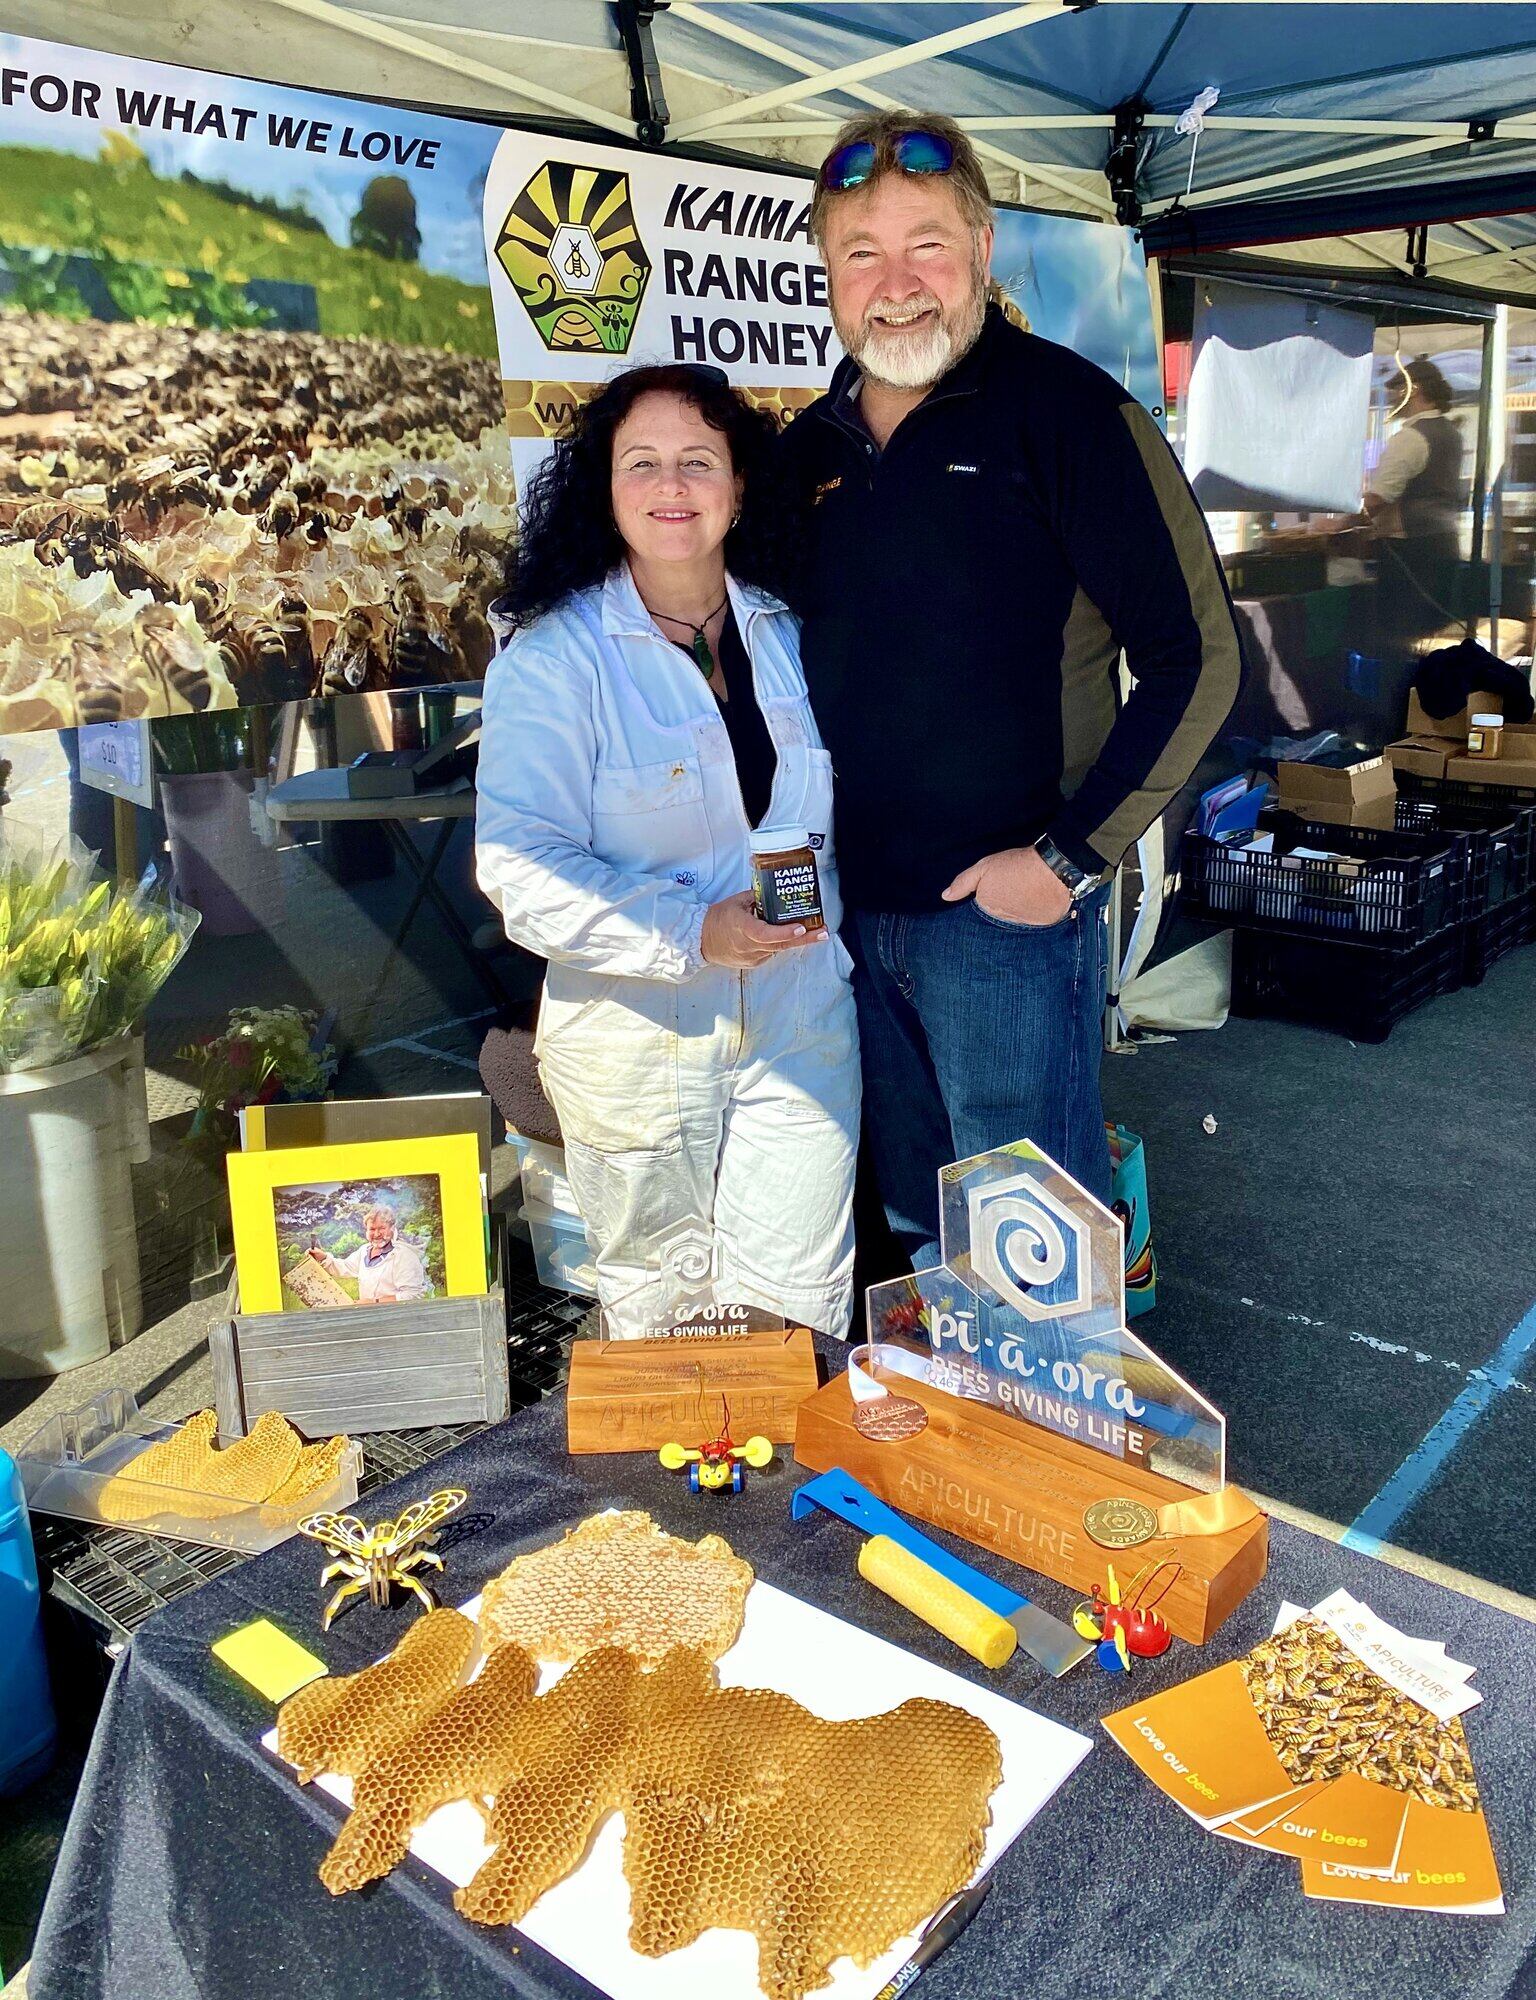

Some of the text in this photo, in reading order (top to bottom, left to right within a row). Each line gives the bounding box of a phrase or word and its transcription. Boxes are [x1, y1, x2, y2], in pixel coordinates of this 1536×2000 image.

[2, 68, 441, 169] FOR WHAT WE LOVE
[663, 183, 815, 245] KAIMA
[663, 249, 829, 307] RANGE
[670, 315, 833, 367] HONEY
[774, 865, 813, 878] KAIMAI
[775, 874, 815, 887] RANGE
[776, 882, 815, 896] HONEY
[673, 1326, 717, 1337] GIVING
[720, 1324, 748, 1336] LIFE
[600, 1395, 788, 1428] APICULTURE
[932, 1354, 1144, 1455] BEES GIVING LIFE
[900, 1464, 1077, 1562] APICULTURE
[1371, 1642, 1453, 1701] APICULTURE
[1133, 1716, 1219, 1800] Love our bees
[1282, 1821, 1368, 1848] our bees
[1416, 1869, 1466, 1885] bees
